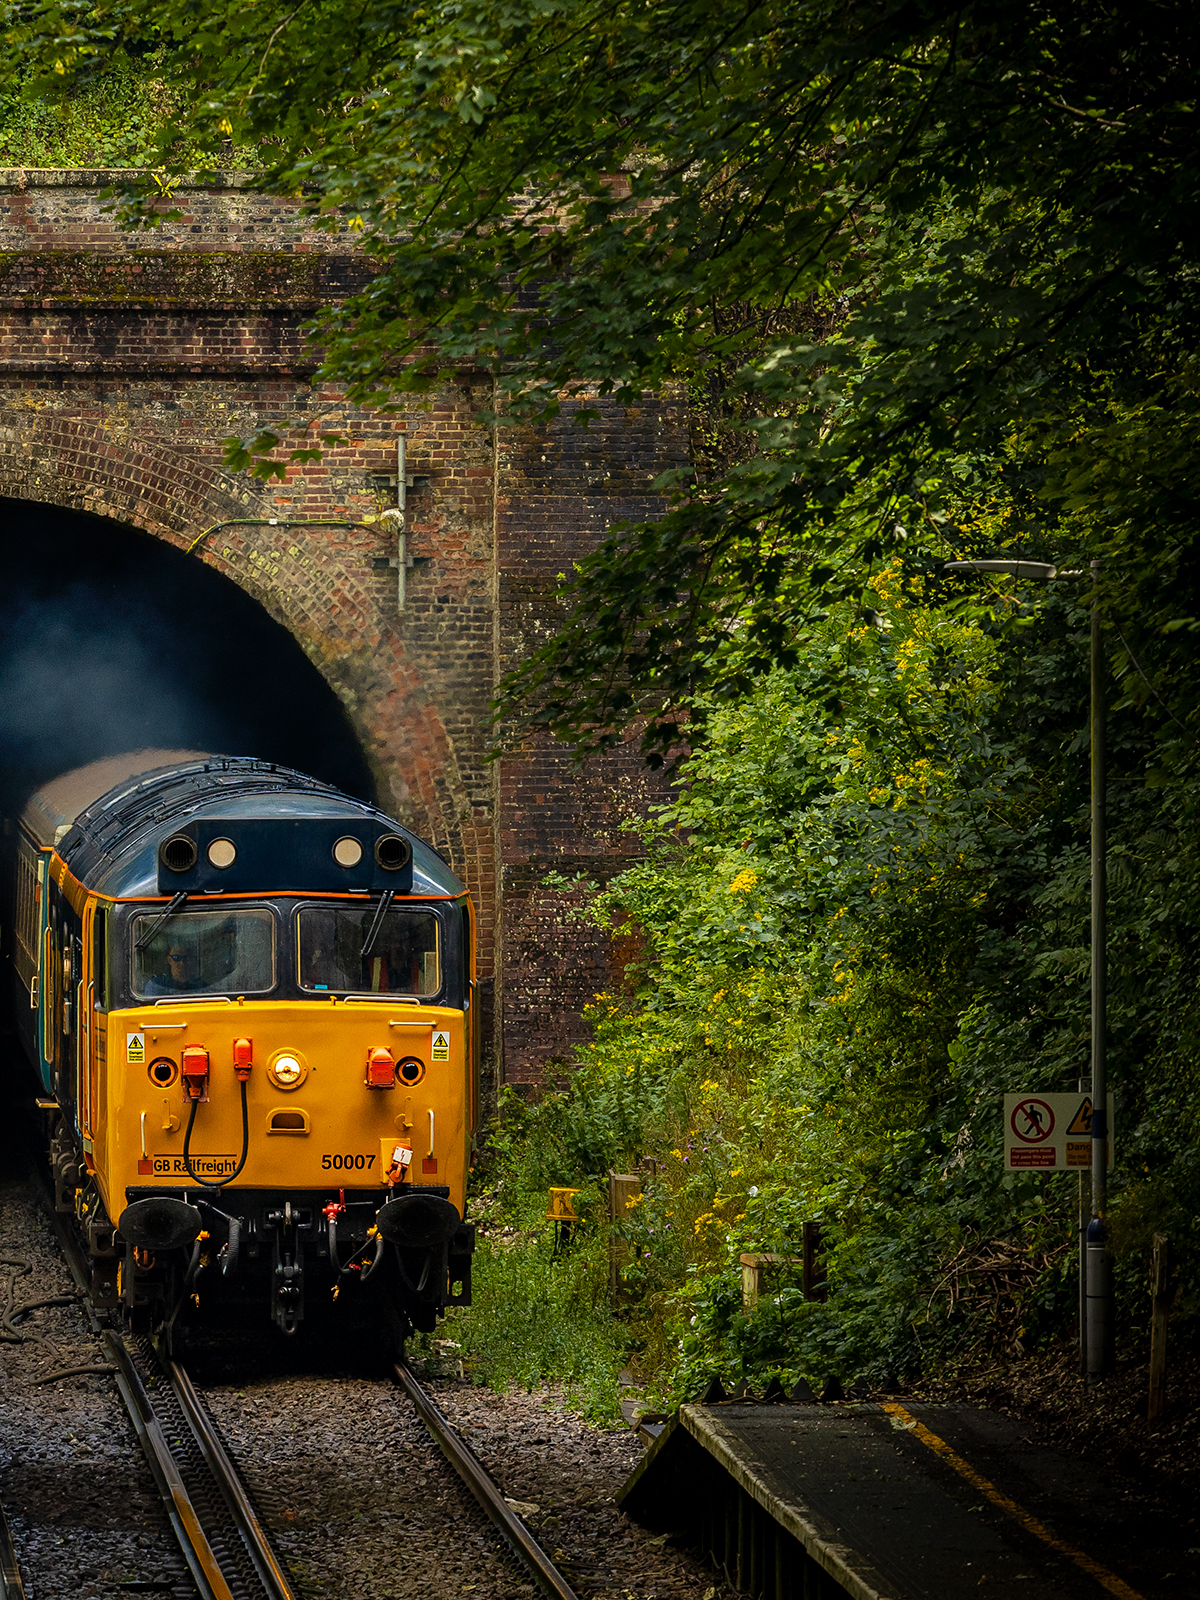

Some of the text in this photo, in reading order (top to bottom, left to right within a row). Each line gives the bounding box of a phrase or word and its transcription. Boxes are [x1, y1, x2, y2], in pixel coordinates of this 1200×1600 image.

[1067, 1142, 1092, 1152] Dang
[153, 1159, 170, 1172] GB
[321, 1154, 376, 1170] 50007
